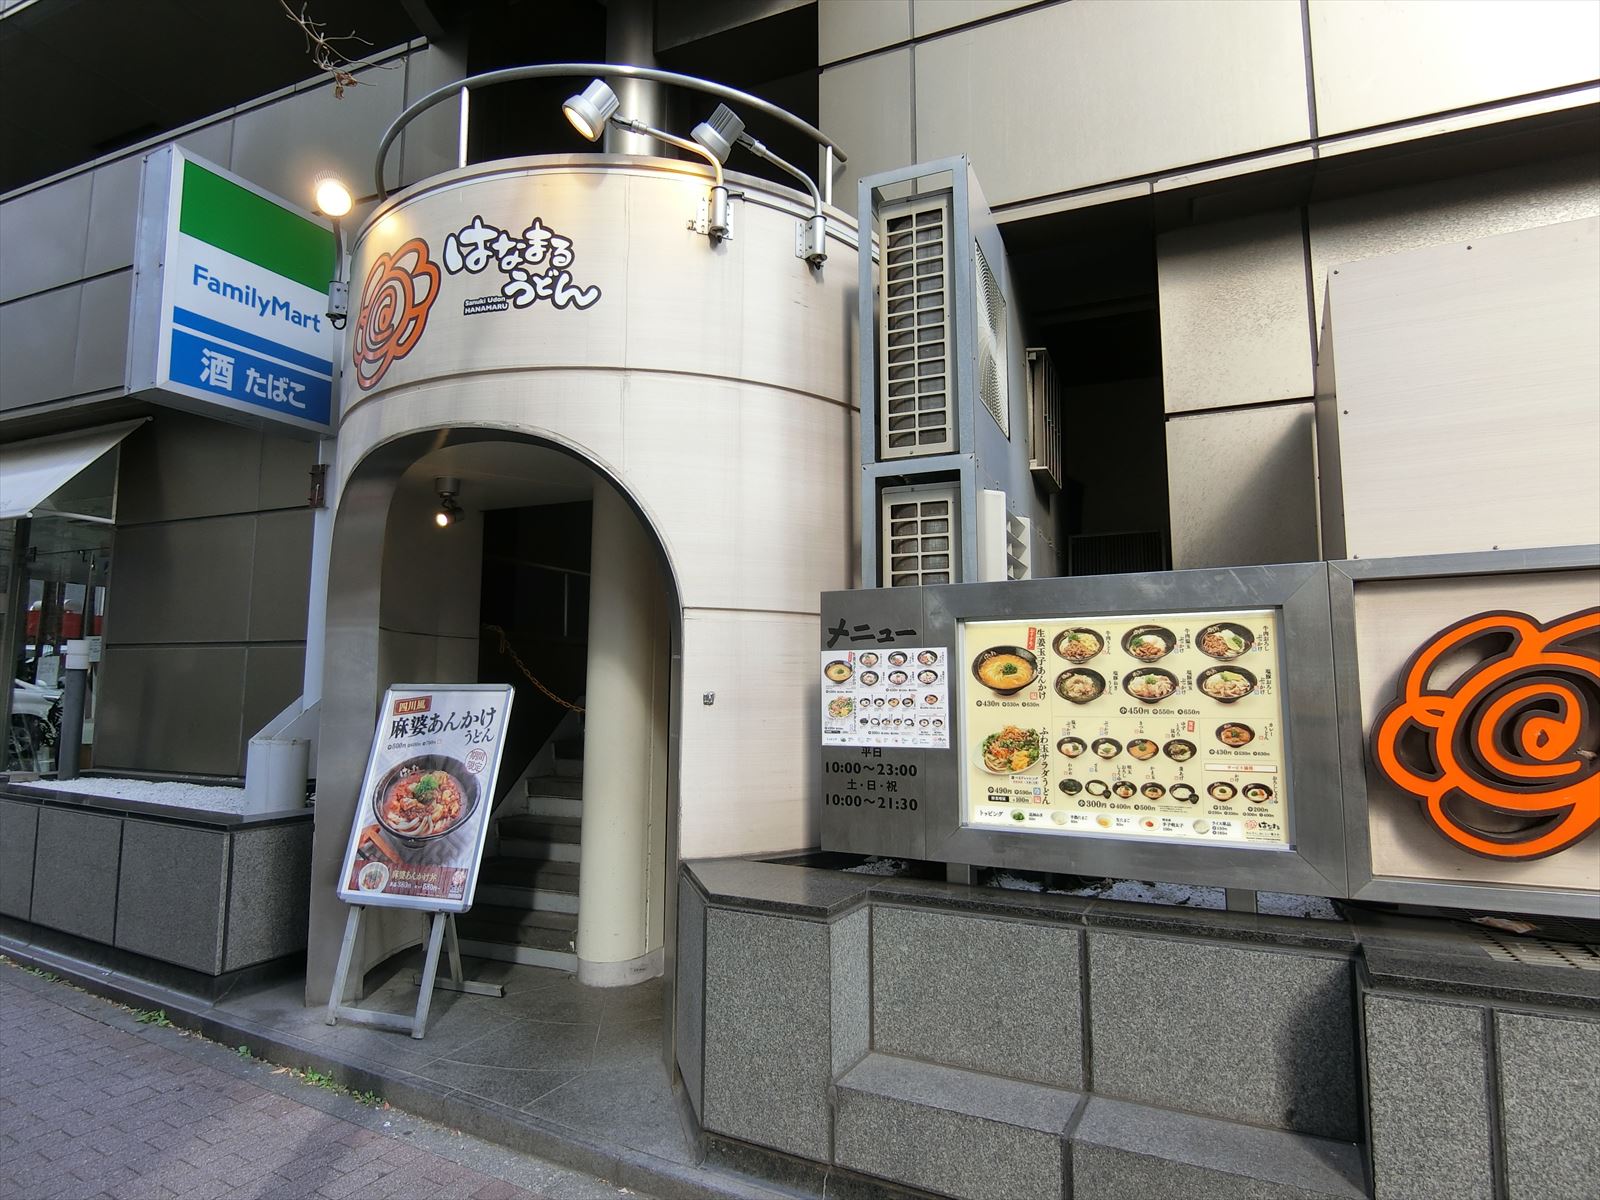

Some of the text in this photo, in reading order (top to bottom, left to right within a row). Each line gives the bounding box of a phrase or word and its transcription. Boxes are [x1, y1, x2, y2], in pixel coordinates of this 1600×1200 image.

[443, 215, 575, 275] はなまる
[193, 264, 320, 333] FamilyMart
[501, 270, 602, 310] うどん
[464, 303, 508, 314] HANAMARU
[200, 348, 306, 409] 酒 たばこ
[827, 618, 917, 648] メニュー
[398, 699, 426, 713] 四川風
[389, 707, 497, 739] 麻婆あんかけ
[465, 728, 495, 746] うどん
[861, 747, 882, 757] 平日
[1039, 727, 1051, 805] ふわ玉サラダうどん
